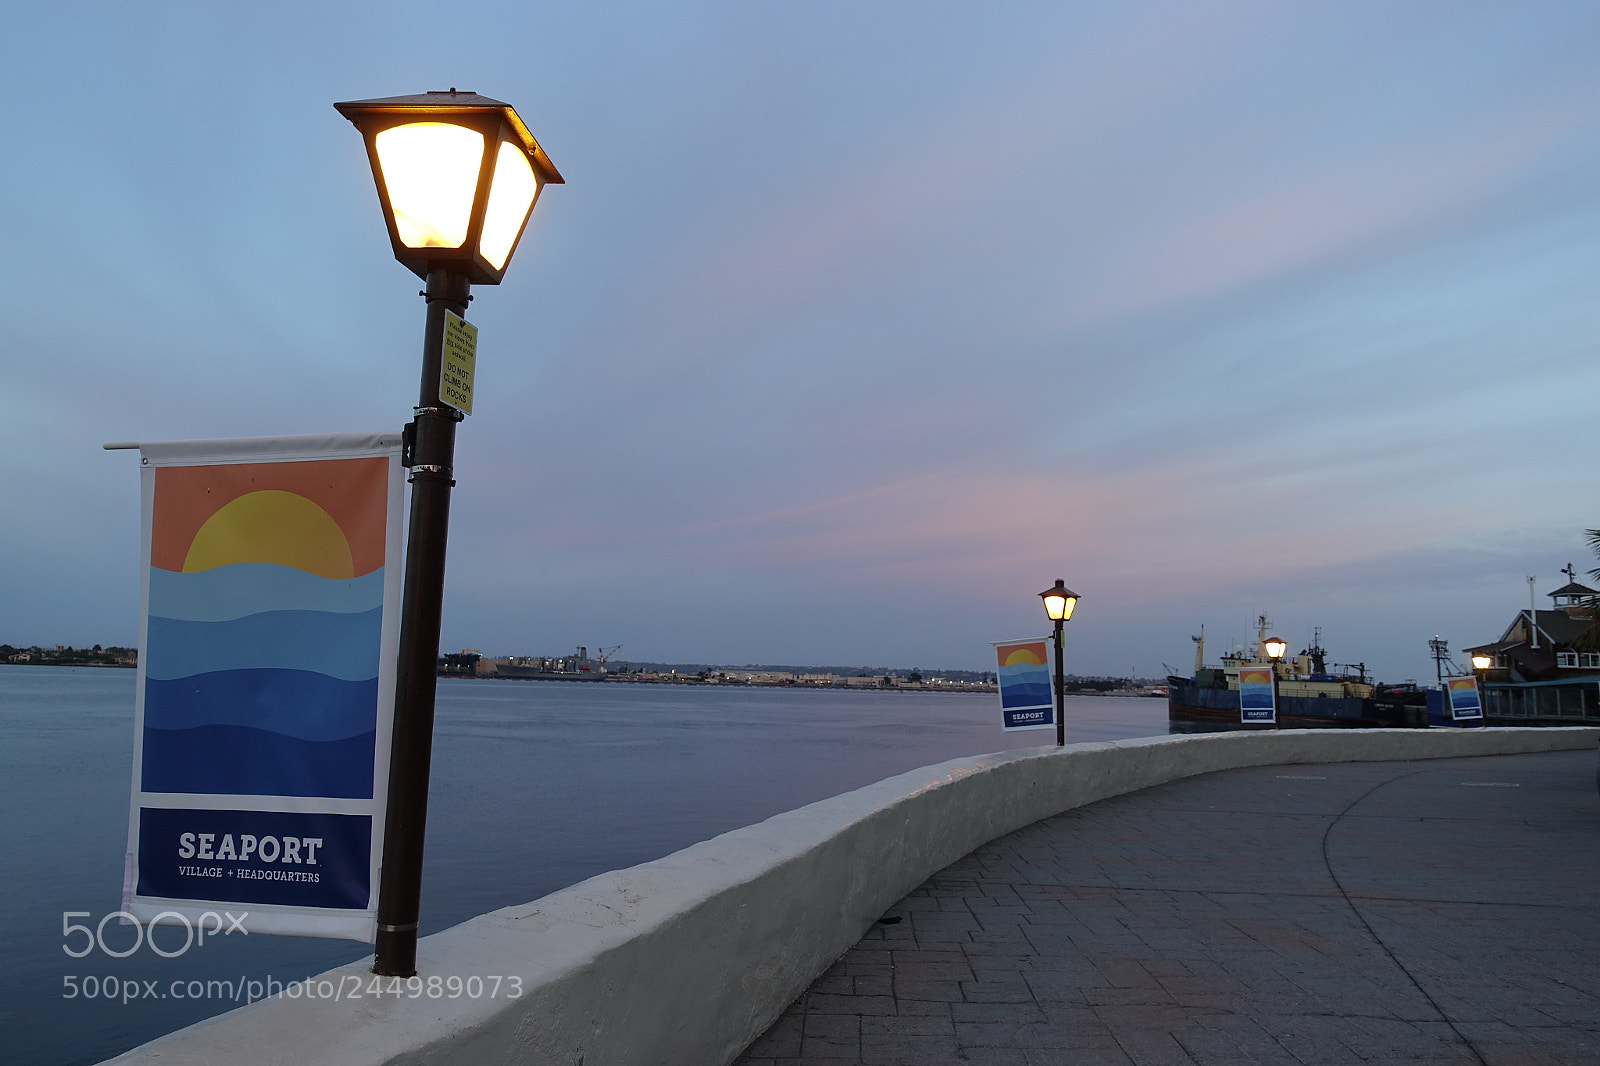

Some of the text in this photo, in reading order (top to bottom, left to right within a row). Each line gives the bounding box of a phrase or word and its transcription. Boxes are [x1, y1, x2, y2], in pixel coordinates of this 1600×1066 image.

[448, 362, 469, 380] DO NOT
[444, 372, 471, 394] CLIMB ON
[446, 386, 467, 403] ROCKS
[178, 832, 323, 864] SEAPORT
[178, 866, 223, 878] VILLAGE
[236, 868, 320, 883] HEADQUARTERS
